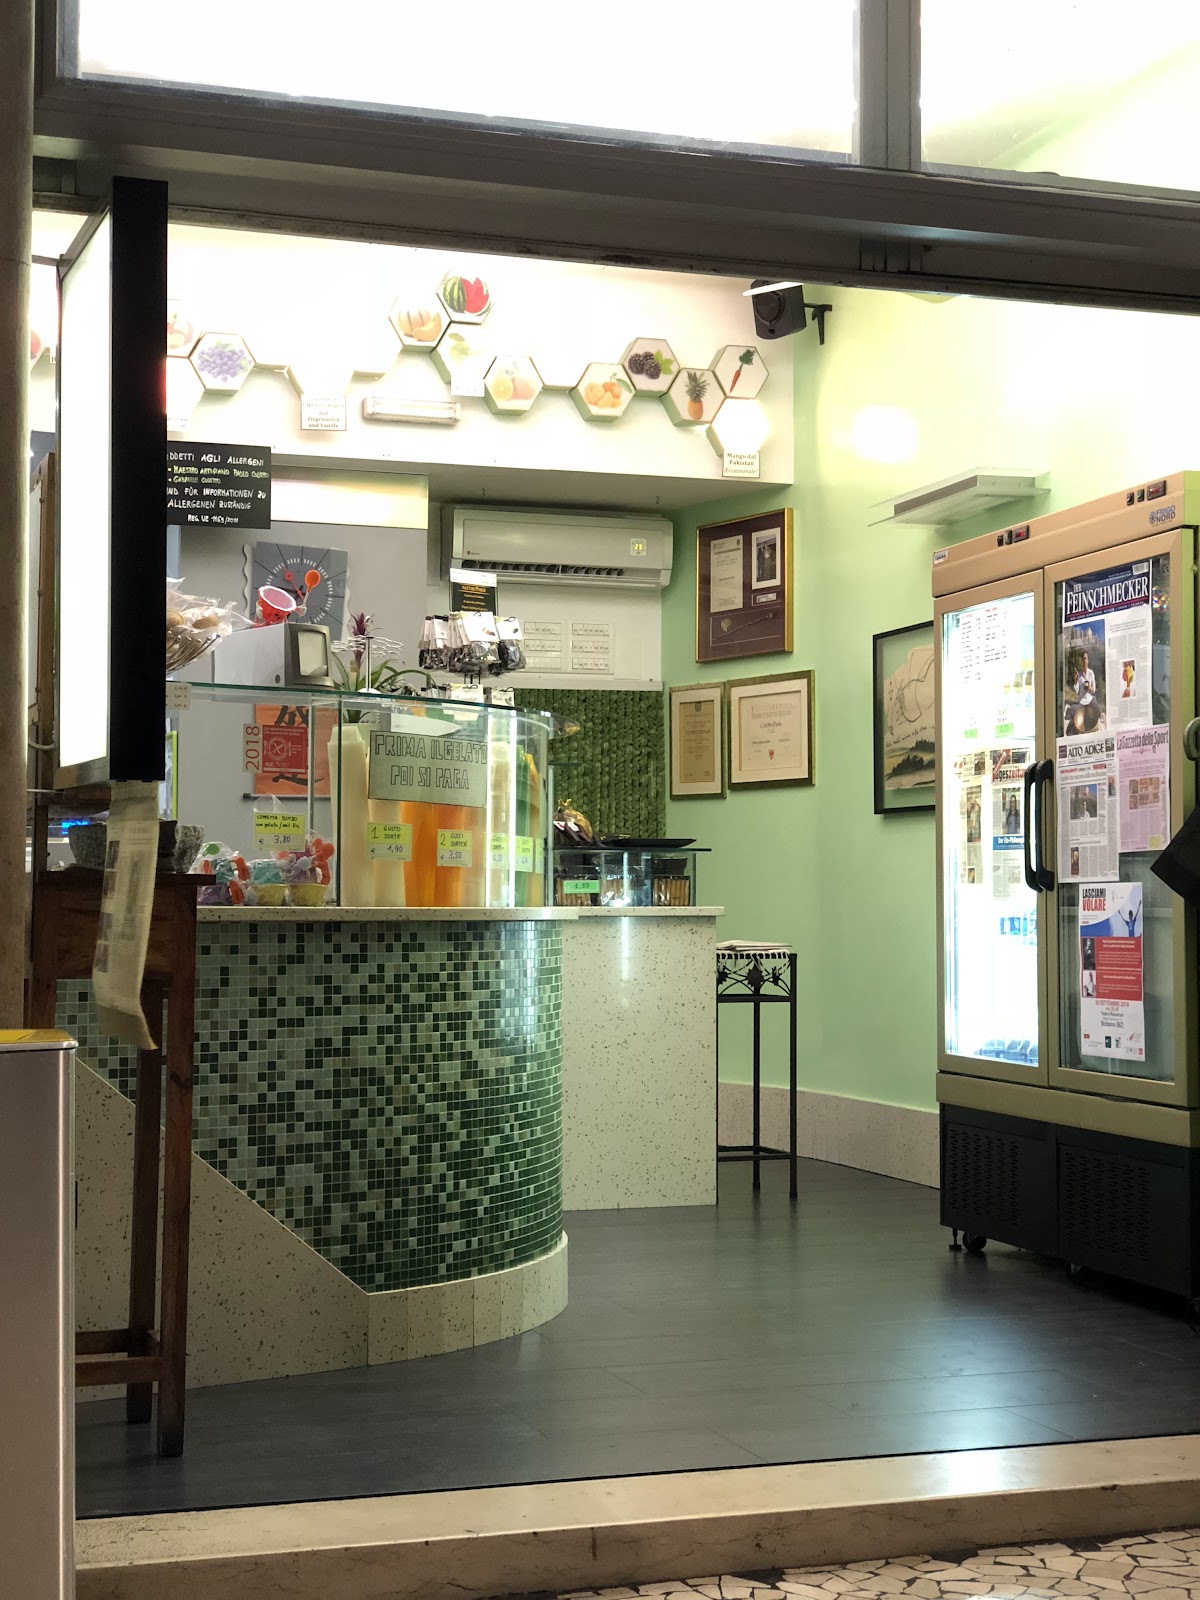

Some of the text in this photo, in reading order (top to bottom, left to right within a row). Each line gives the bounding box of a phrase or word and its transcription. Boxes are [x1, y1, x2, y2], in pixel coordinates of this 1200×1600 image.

[167, 452, 264, 466] DDETTI AGLI ALLERGENI
[184, 486, 198, 496] FÜR
[203, 487, 254, 498] INFORMATIONEN
[167, 499, 215, 509] ALLERGENEN
[1156, 505, 1175, 514] FRIGO
[1156, 512, 1175, 523] NORD
[1073, 583, 1082, 593] DER
[1066, 576, 1148, 614] FEINSCHMECKER
[1154, 730, 1168, 747] Sport
[246, 726, 260, 770] 2018
[375, 735, 426, 758] PRIMA
[1068, 743, 1104, 757] ALTO ADIGE
[391, 765, 469, 789] POI SI PAGA
[371, 826, 379, 839] 1
[274, 835, 290, 844] 3,80
[440, 833, 445, 846] 2
[387, 845, 403, 853] 1,90
[448, 850, 462, 860] 3,50
[1082, 888, 1106, 898] LASCIAMI
[1082, 899, 1106, 911] VOLARE
